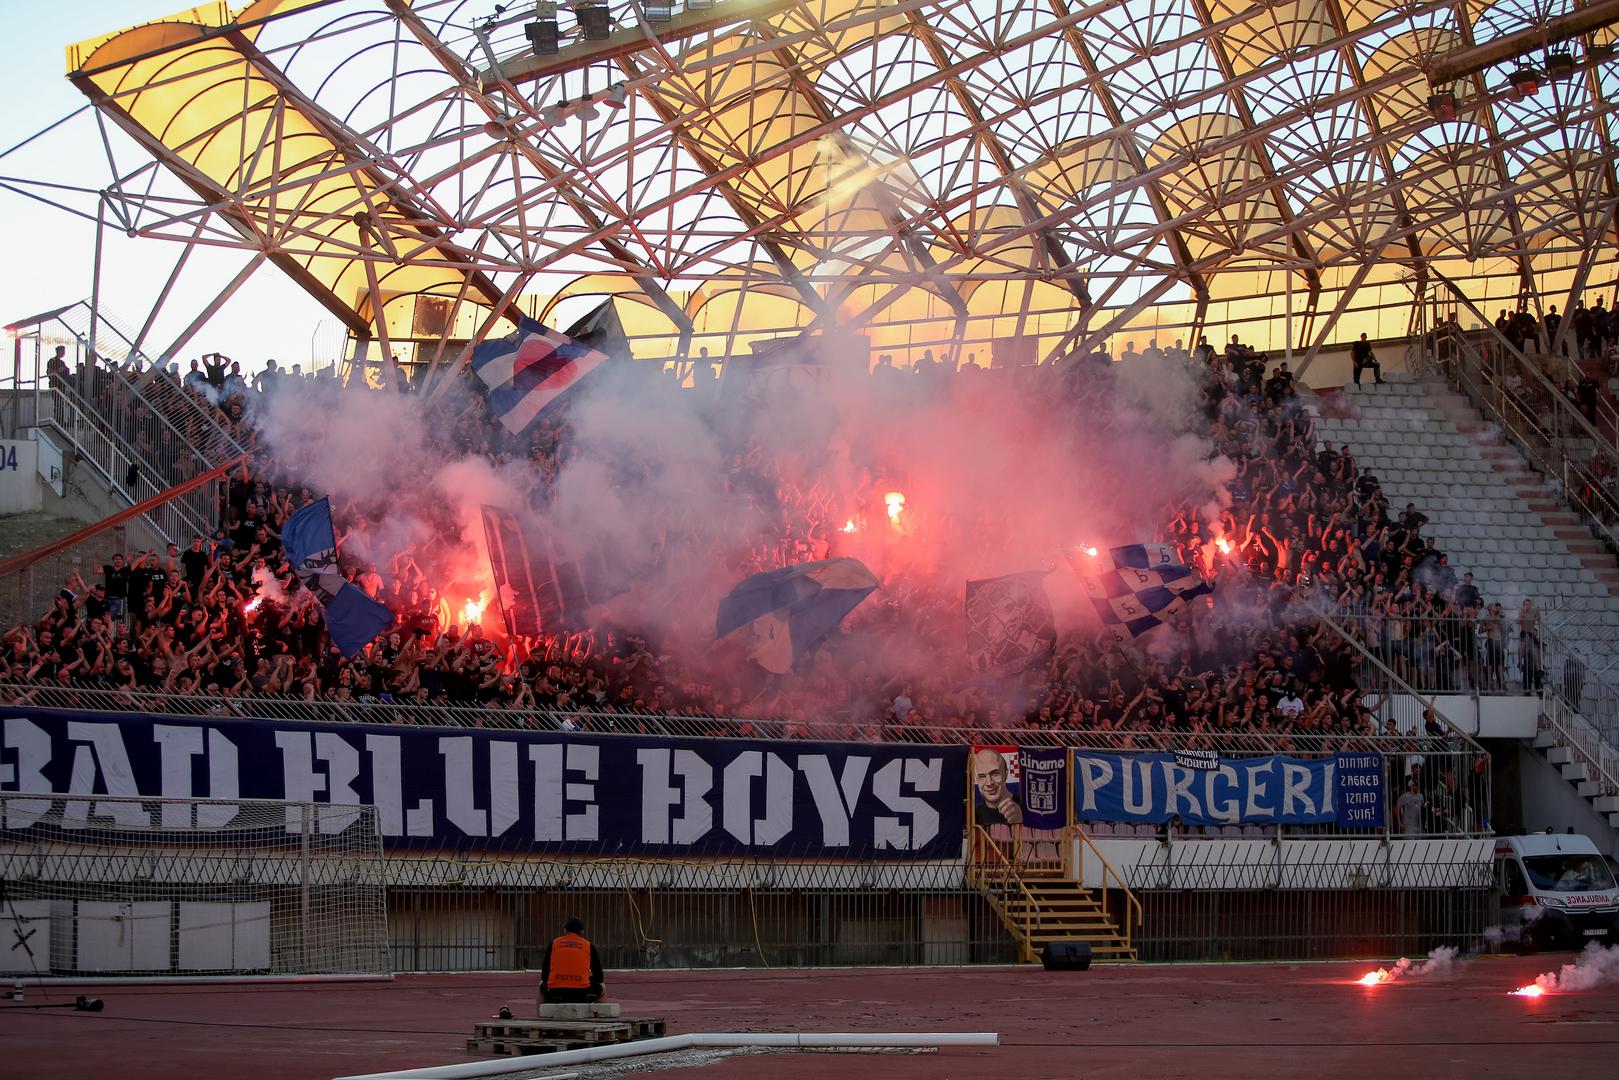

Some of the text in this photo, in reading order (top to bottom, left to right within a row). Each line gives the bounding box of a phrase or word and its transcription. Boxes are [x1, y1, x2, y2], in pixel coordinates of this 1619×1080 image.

[1019, 750, 1066, 770] dinamo
[1175, 755, 1219, 769] suparnik
[1338, 757, 1379, 769] DINAMO
[0, 717, 944, 850] BAD BLUE BOYS
[1340, 775, 1379, 787] ZAGREB
[1076, 755, 1336, 824] PURGERI
[1345, 792, 1377, 804] IZNAD
